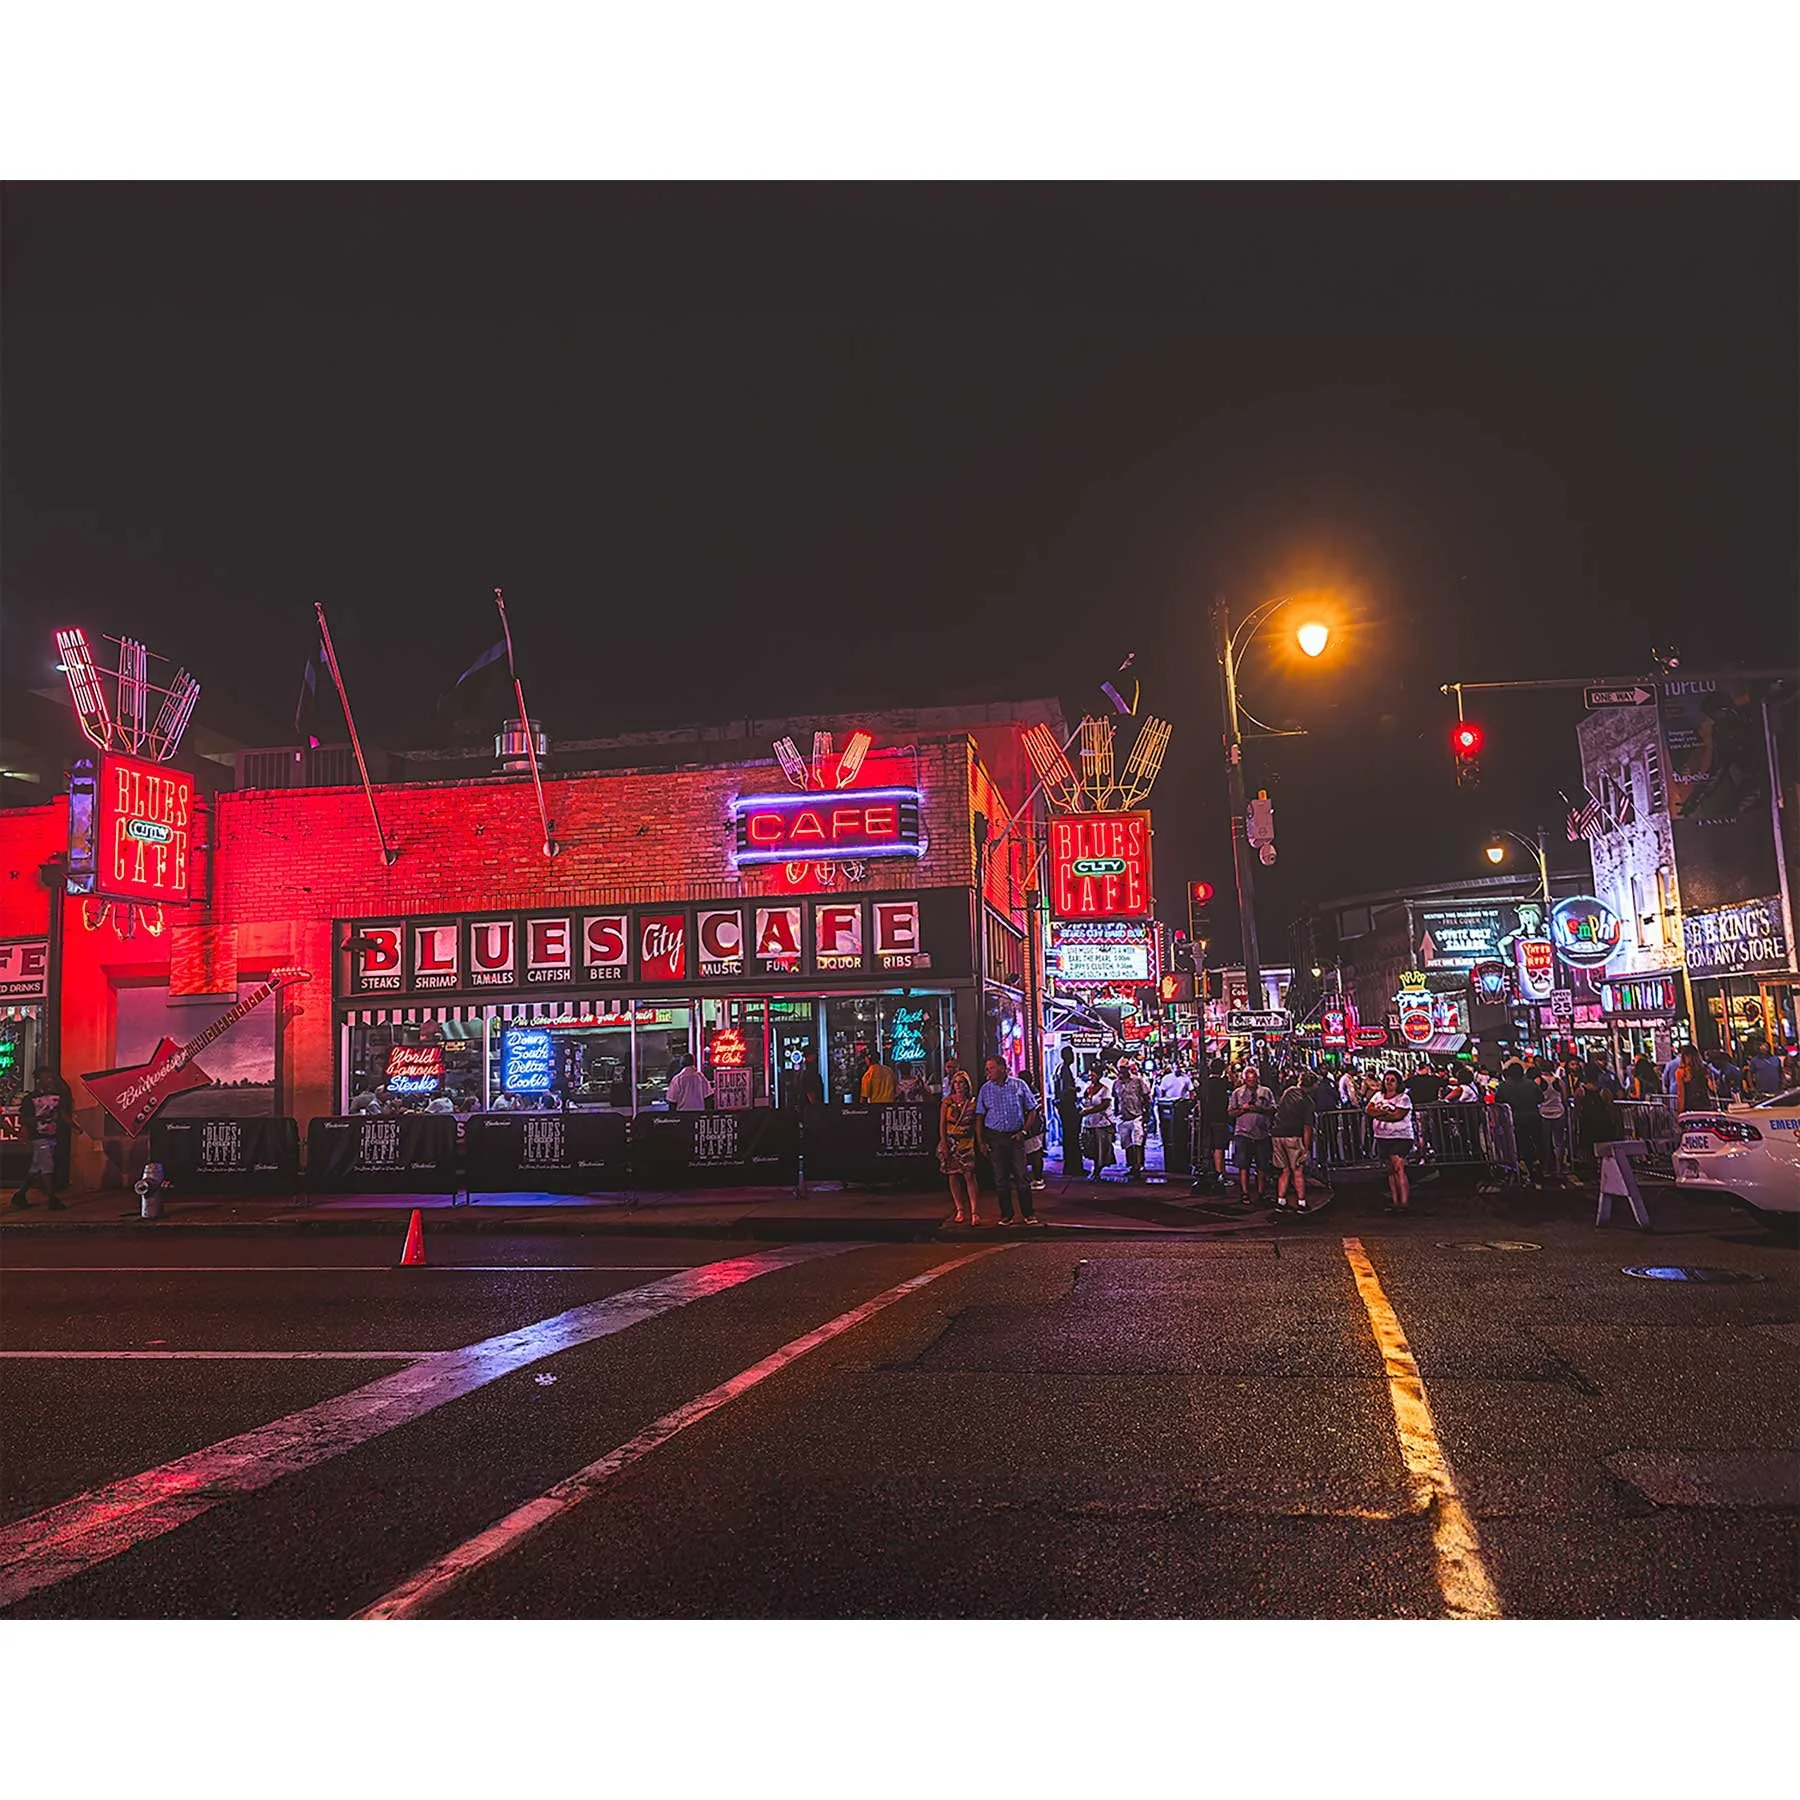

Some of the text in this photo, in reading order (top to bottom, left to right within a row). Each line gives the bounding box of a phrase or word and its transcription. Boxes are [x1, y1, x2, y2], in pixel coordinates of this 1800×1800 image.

[1593, 691, 1636, 702] ONE WAY
[114, 767, 188, 827] BLUES
[752, 807, 893, 840] CAFE
[1058, 821, 1141, 860] BLUES
[114, 816, 187, 890] CAFE
[1077, 861, 1121, 872] CITY
[1060, 860, 1141, 912] CAFE
[1718, 907, 1771, 941] KING'S
[363, 905, 917, 973] BLUES City CAFE
[1739, 936, 1785, 962] STORE
[701, 961, 742, 976] MUSIC
[766, 959, 789, 973] FUN
[818, 957, 862, 970] LIQUOR
[883, 955, 913, 968] RIBS
[360, 976, 401, 989] STEAKS
[415, 975, 458, 988] SHRIMP
[471, 972, 514, 985] TAMALES
[527, 969, 571, 982] CATFISH
[590, 968, 621, 980] BEER
[10, 982, 41, 993] DRINKS
[1553, 1002, 1572, 1013] 25
[391, 1047, 435, 1064] World
[510, 1043, 549, 1060] South
[115, 1049, 189, 1109] Budweiser
[386, 1074, 438, 1091] Steaks
[719, 1072, 747, 1087] BLUES
[699, 1117, 734, 1135] BLUES
[886, 1110, 918, 1126] BLUES
[1769, 1119, 1800, 1130] EMER
[206, 1126, 238, 1141] BLUES
[365, 1123, 397, 1139] BLUES
[527, 1121, 561, 1138] BLUES
[886, 1125, 918, 1146] CAFE
[206, 1140, 238, 1161] CAFE
[364, 1139, 396, 1160] CAFE
[527, 1137, 561, 1158] CAFE
[699, 1134, 734, 1156] CAFE
